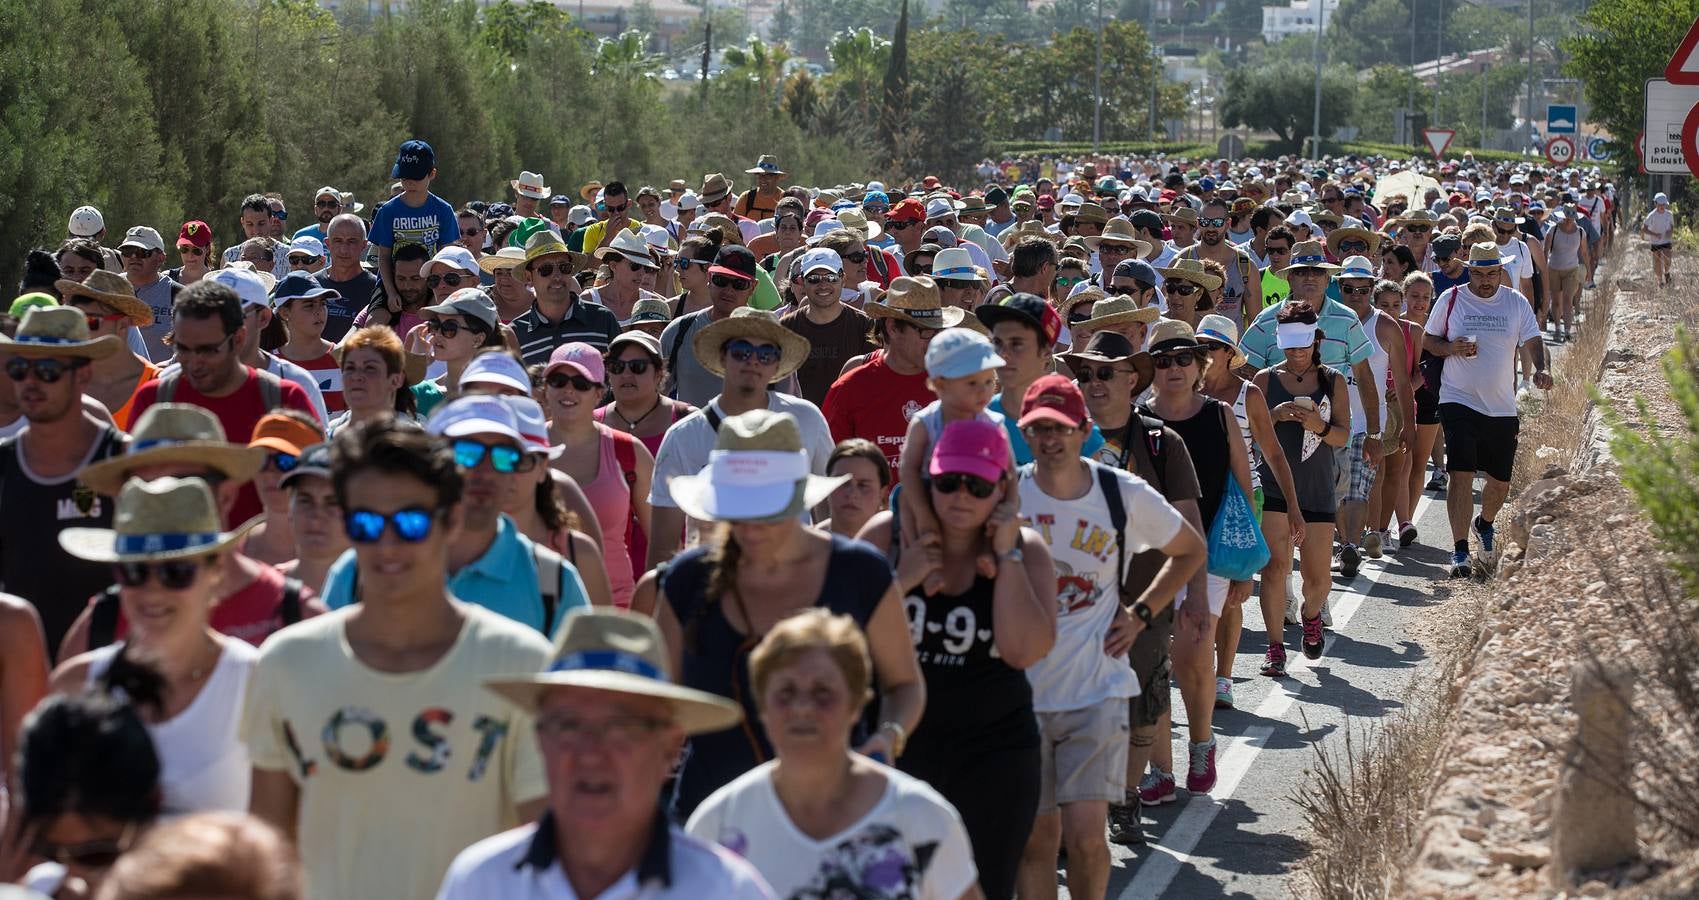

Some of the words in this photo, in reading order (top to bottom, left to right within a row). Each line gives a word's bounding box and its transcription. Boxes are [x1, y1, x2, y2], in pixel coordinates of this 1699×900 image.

[1552, 146, 1569, 156] 20
[393, 214, 440, 230] ORIGINAL
[283, 707, 509, 783] LOST
